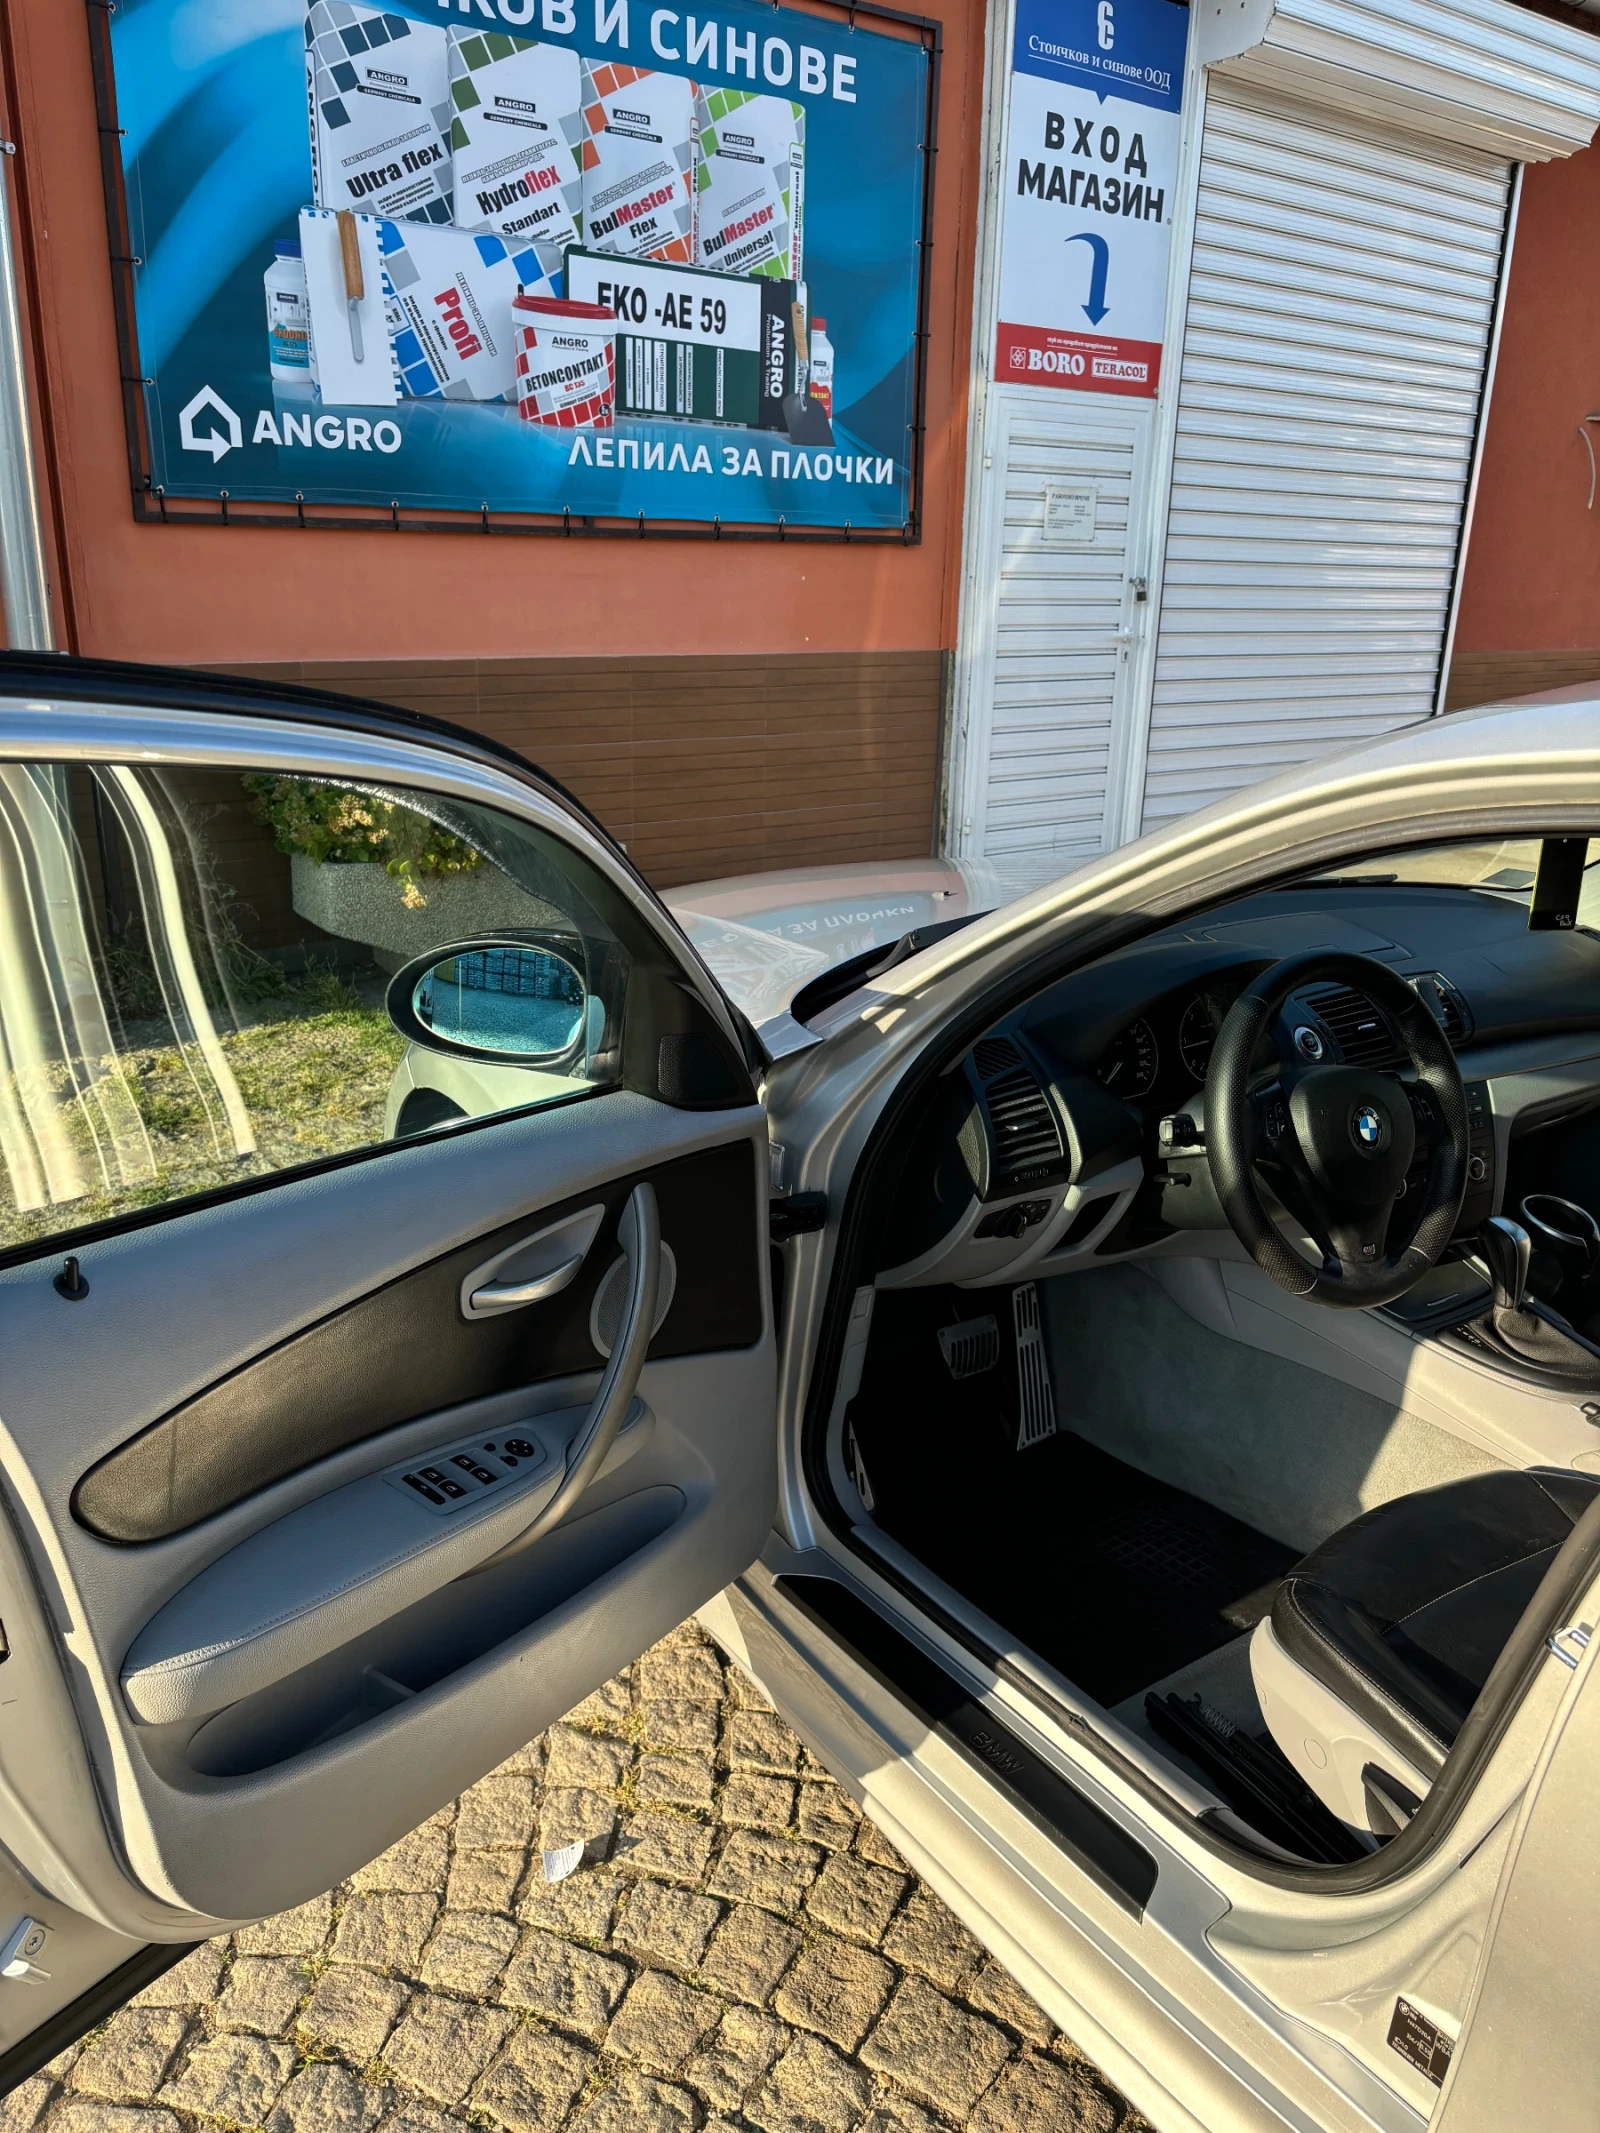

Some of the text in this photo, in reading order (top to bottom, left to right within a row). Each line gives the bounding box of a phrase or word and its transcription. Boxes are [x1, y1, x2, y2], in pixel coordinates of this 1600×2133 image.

[595, 0, 629, 49] И
[650, 8, 857, 104] СИНОВЕ
[1028, 34, 1171, 90] Стоичков и синове ООД
[370, 71, 406, 85] ANGRO
[490, 115, 514, 124] GERMANY
[497, 98, 534, 111] ANGRO
[616, 111, 648, 123] ANGRO
[725, 134, 753, 146] ANGRO
[1044, 111, 1148, 178] ВХОД
[346, 143, 444, 198] Ultra flex
[475, 165, 562, 216] Hydroflex
[1017, 158, 1165, 223] МАГАЗИН
[501, 202, 561, 235] Standart
[589, 184, 675, 240] BulMaster
[629, 217, 658, 239] Flex
[703, 205, 774, 256] BulMaster
[724, 230, 774, 266] Universal
[433, 287, 483, 361] Profi
[700, 297, 727, 335] 59
[552, 336, 588, 348] ANGRO
[770, 315, 785, 398] ANGRO
[1027, 349, 1085, 376] BORO
[525, 353, 604, 393] BETONCONTAKT
[252, 410, 402, 454] ANGRO
[568, 435, 894, 485] ЛЕПИЛА ЗА ПЛОЧКИ
[969, 1731, 1025, 1774] BMW
